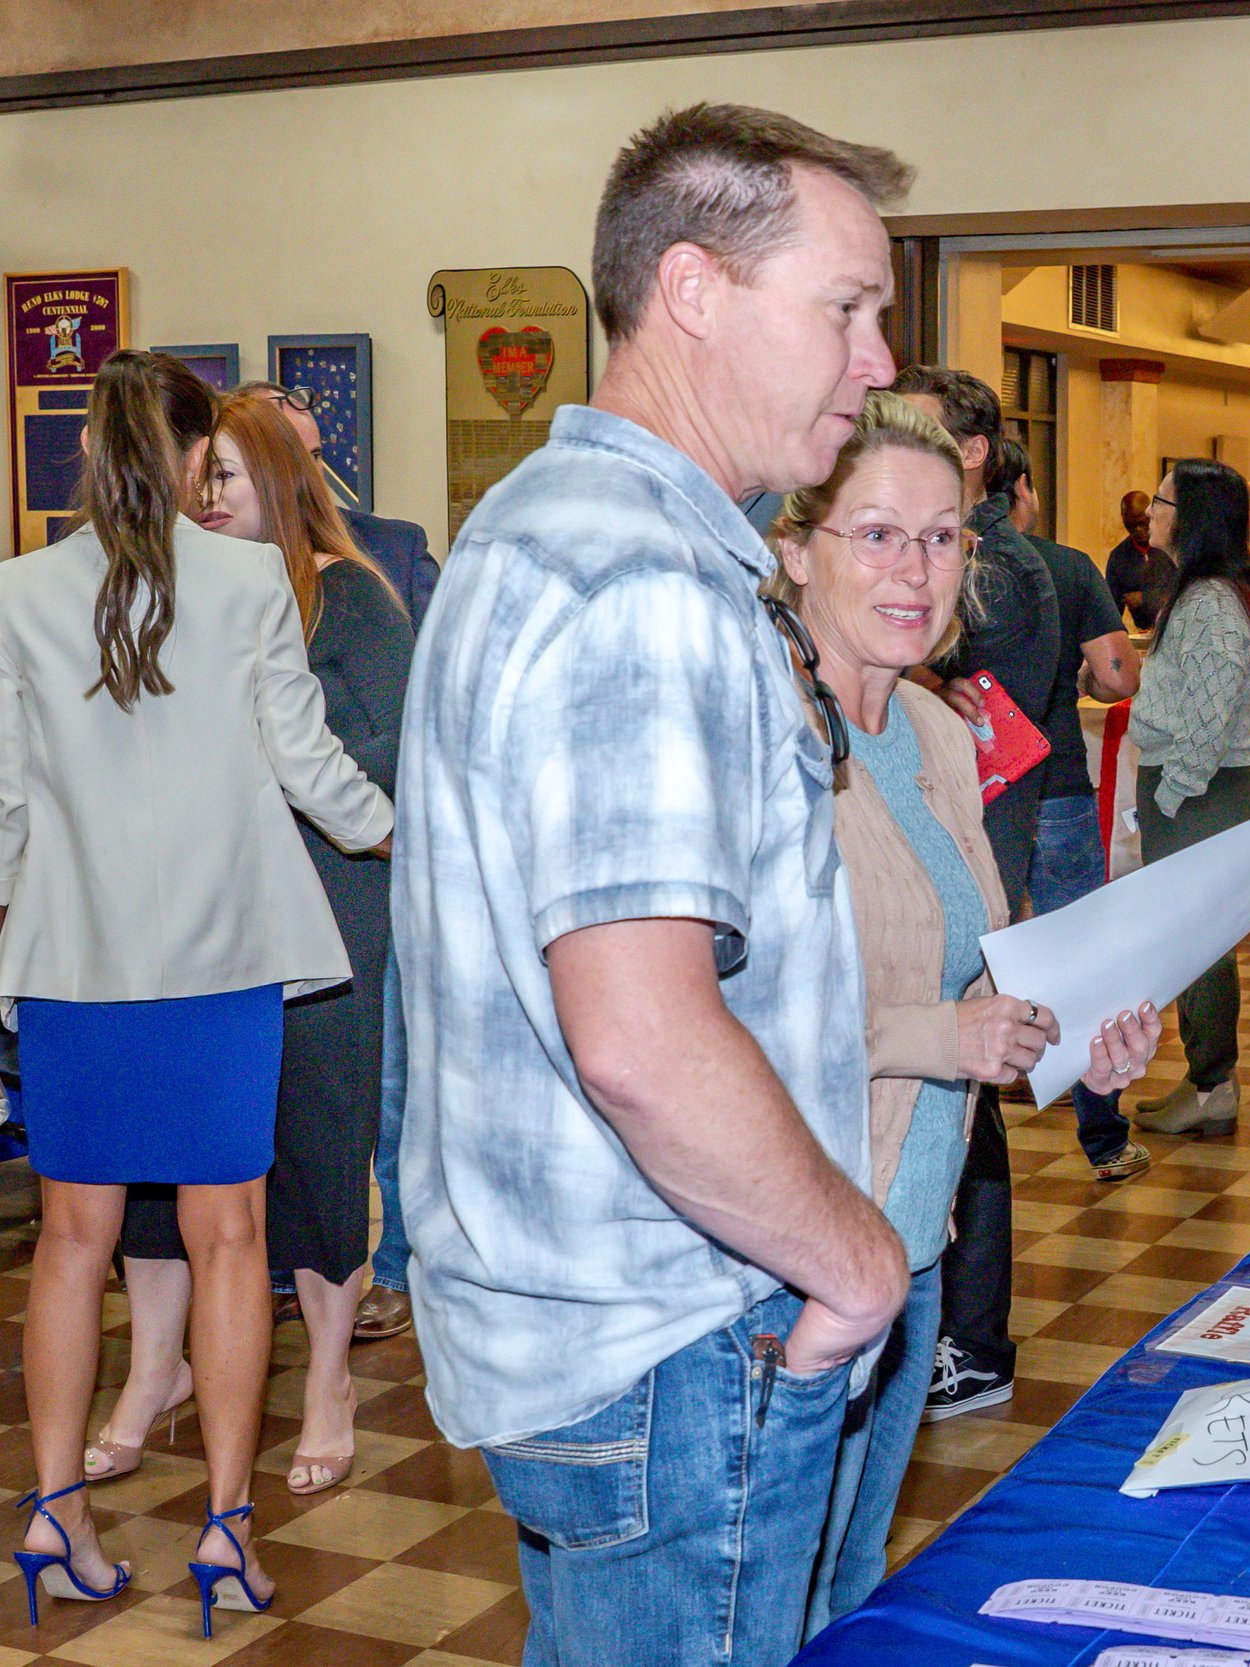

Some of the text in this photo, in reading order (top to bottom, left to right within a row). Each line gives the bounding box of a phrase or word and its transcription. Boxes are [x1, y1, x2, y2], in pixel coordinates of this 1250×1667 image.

[486, 273, 528, 302] Elks
[21, 295, 42, 313] RENO
[44, 290, 63, 302] ELKS
[65, 290, 90, 301] LODGE
[42, 305, 88, 315] CENTENNIAL
[447, 298, 579, 322] National Foundation
[492, 361, 534, 373] MEMBER
[1152, 1437, 1181, 1458] TICKET
[1016, 1597, 1057, 1606] TICKET
[1084, 1599, 1126, 1611] TICKET
[1154, 1607, 1196, 1619] TICKET
